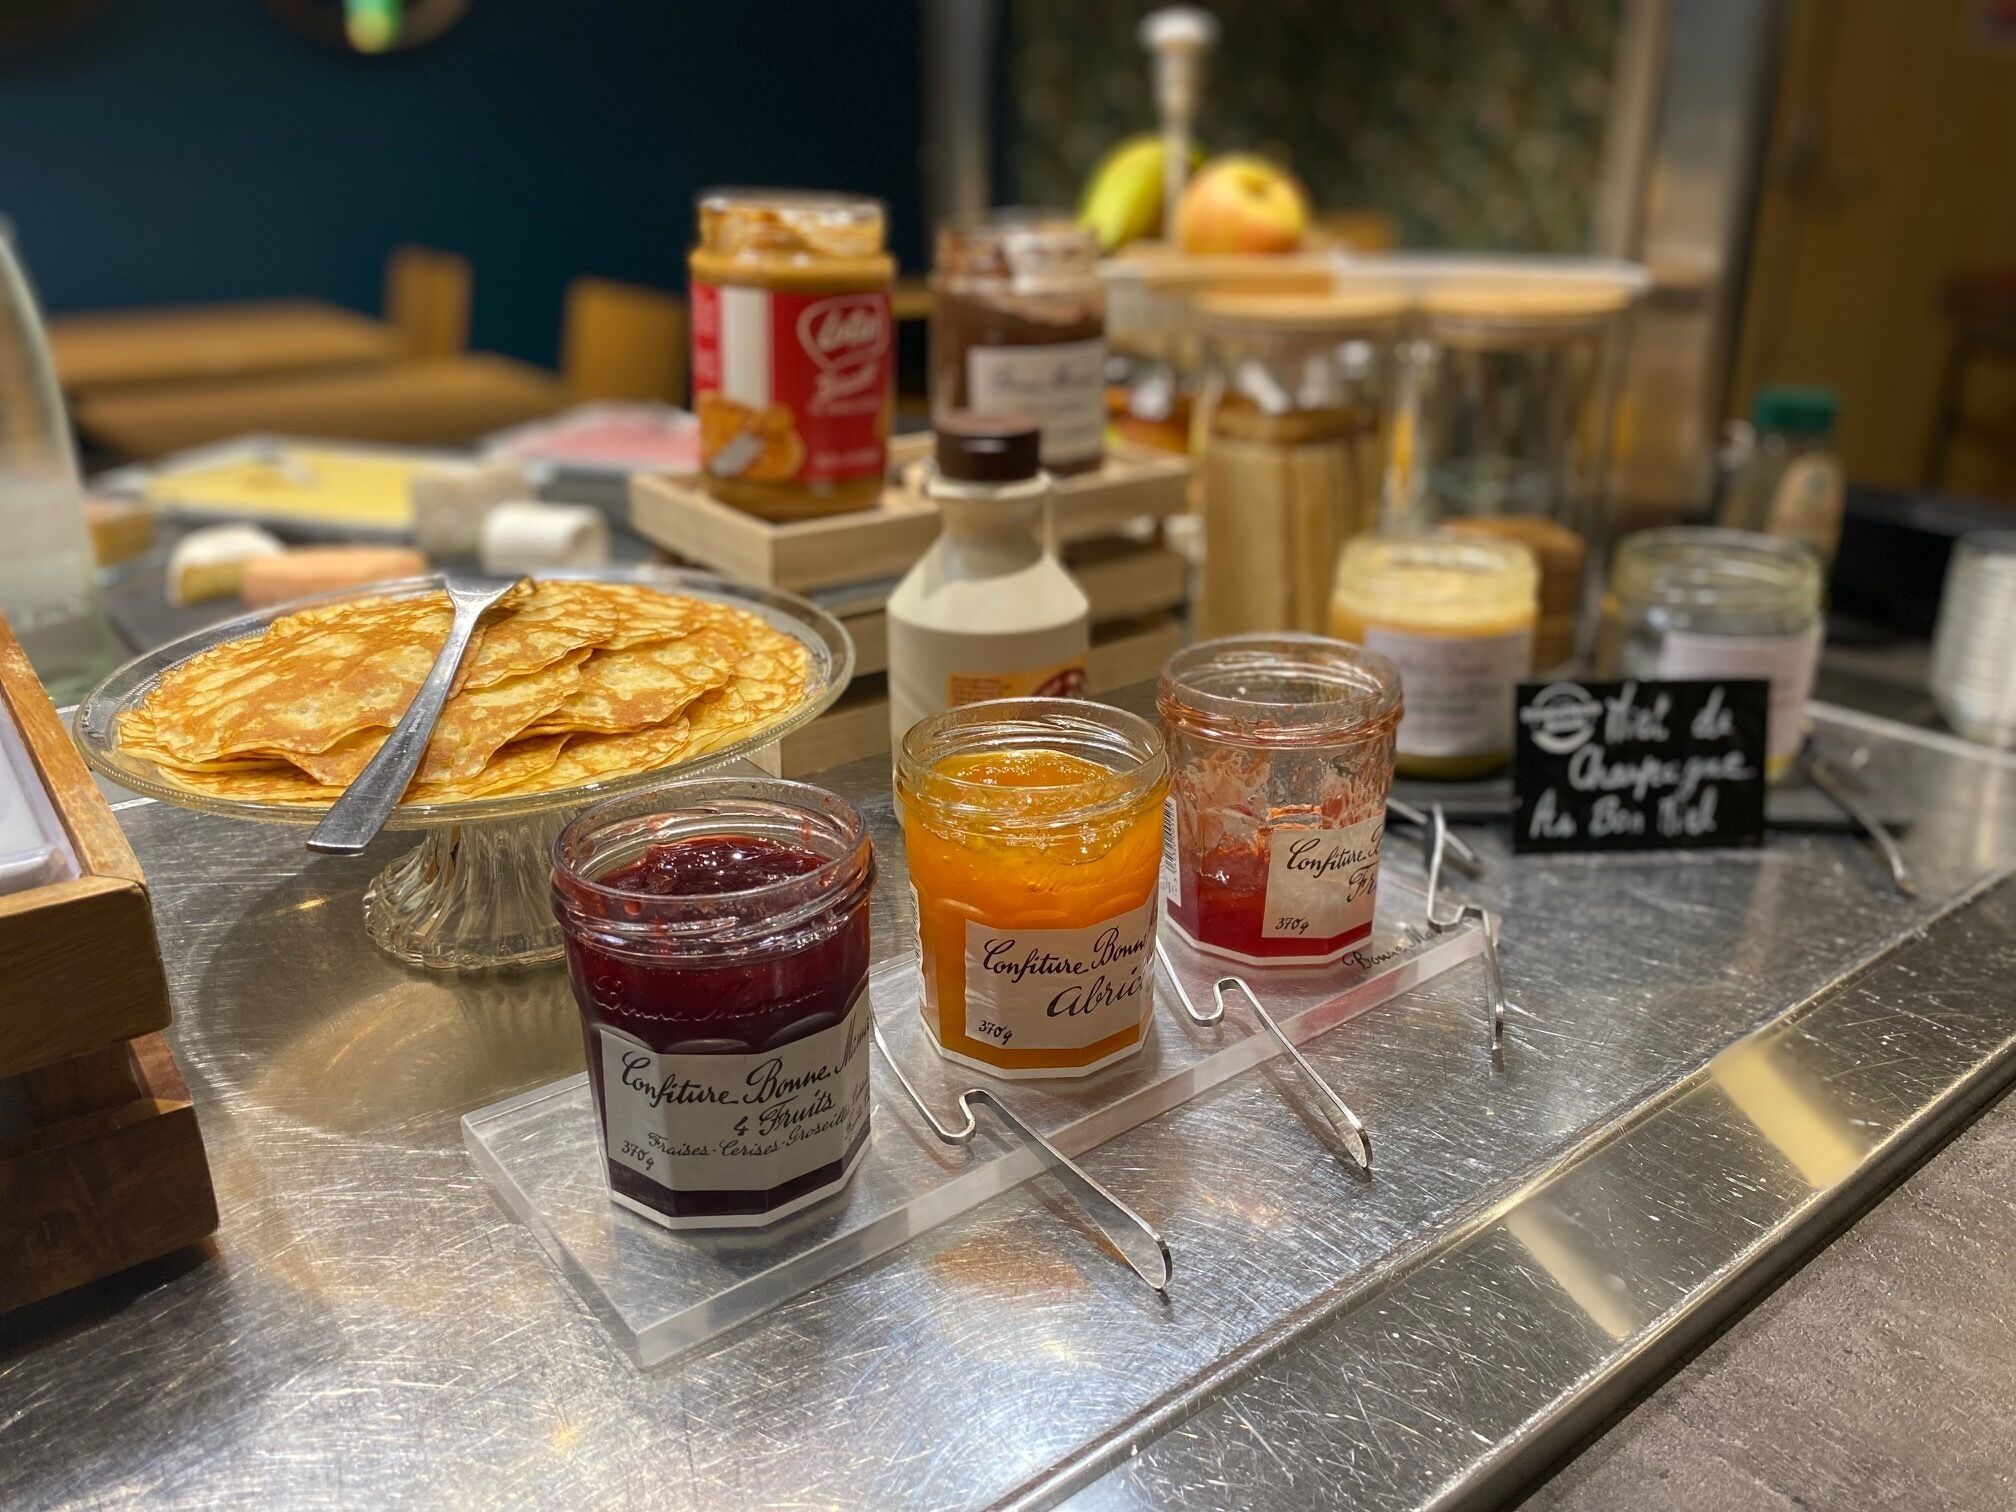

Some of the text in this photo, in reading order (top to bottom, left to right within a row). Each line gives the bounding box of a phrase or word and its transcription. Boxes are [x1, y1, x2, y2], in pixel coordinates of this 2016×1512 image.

[1286, 838, 1366, 879] Confiture
[983, 938, 1089, 983] Confiture
[621, 1051, 739, 1107] Confiture
[743, 1056, 831, 1104] Bonne
[733, 1116, 749, 1136] 4
[758, 1089, 836, 1136] Fruits
